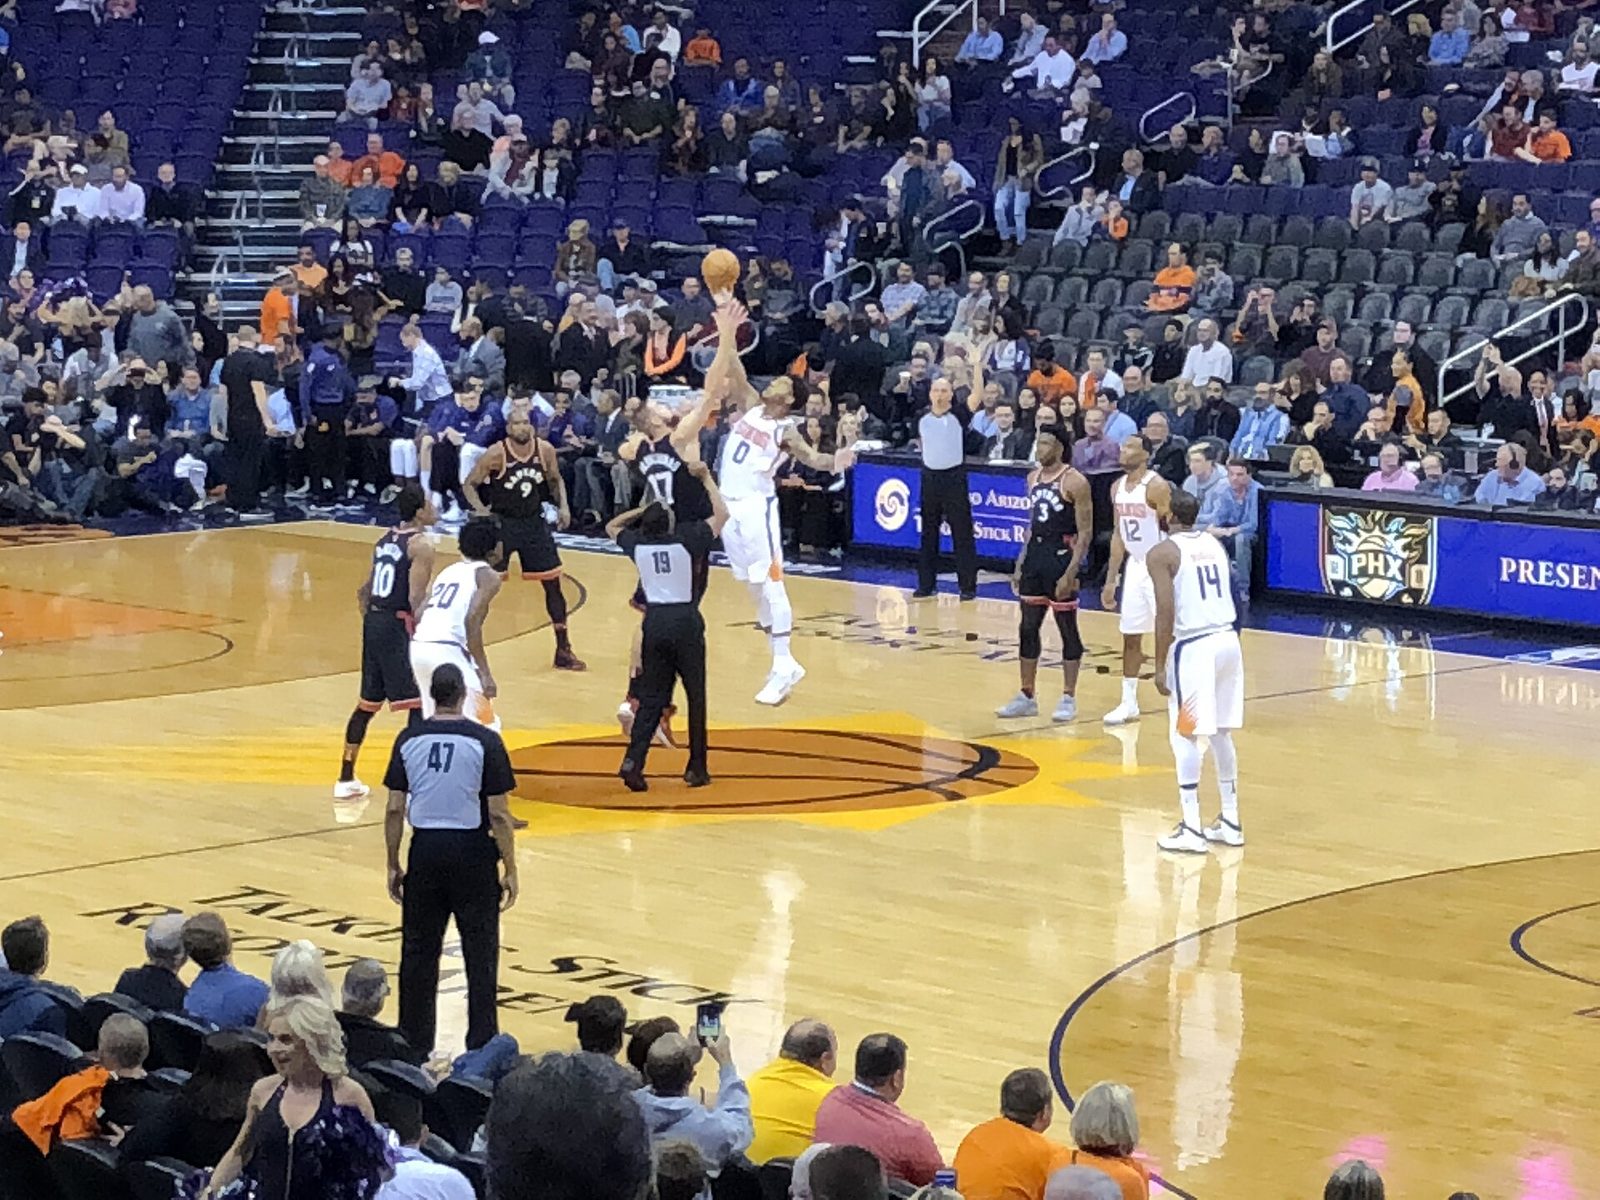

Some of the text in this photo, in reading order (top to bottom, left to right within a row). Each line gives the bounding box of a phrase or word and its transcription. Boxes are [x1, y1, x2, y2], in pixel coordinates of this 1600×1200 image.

[732, 440, 750, 465] 0
[520, 481, 533, 498] 9
[985, 489, 1031, 510] ARIZO
[1037, 502, 1049, 523] 3
[1123, 518, 1143, 542] 12
[651, 550, 672, 575] 19
[1350, 552, 1403, 581] PHX
[371, 561, 395, 598] 10
[1196, 563, 1222, 600] 14
[427, 741, 455, 774] 47
